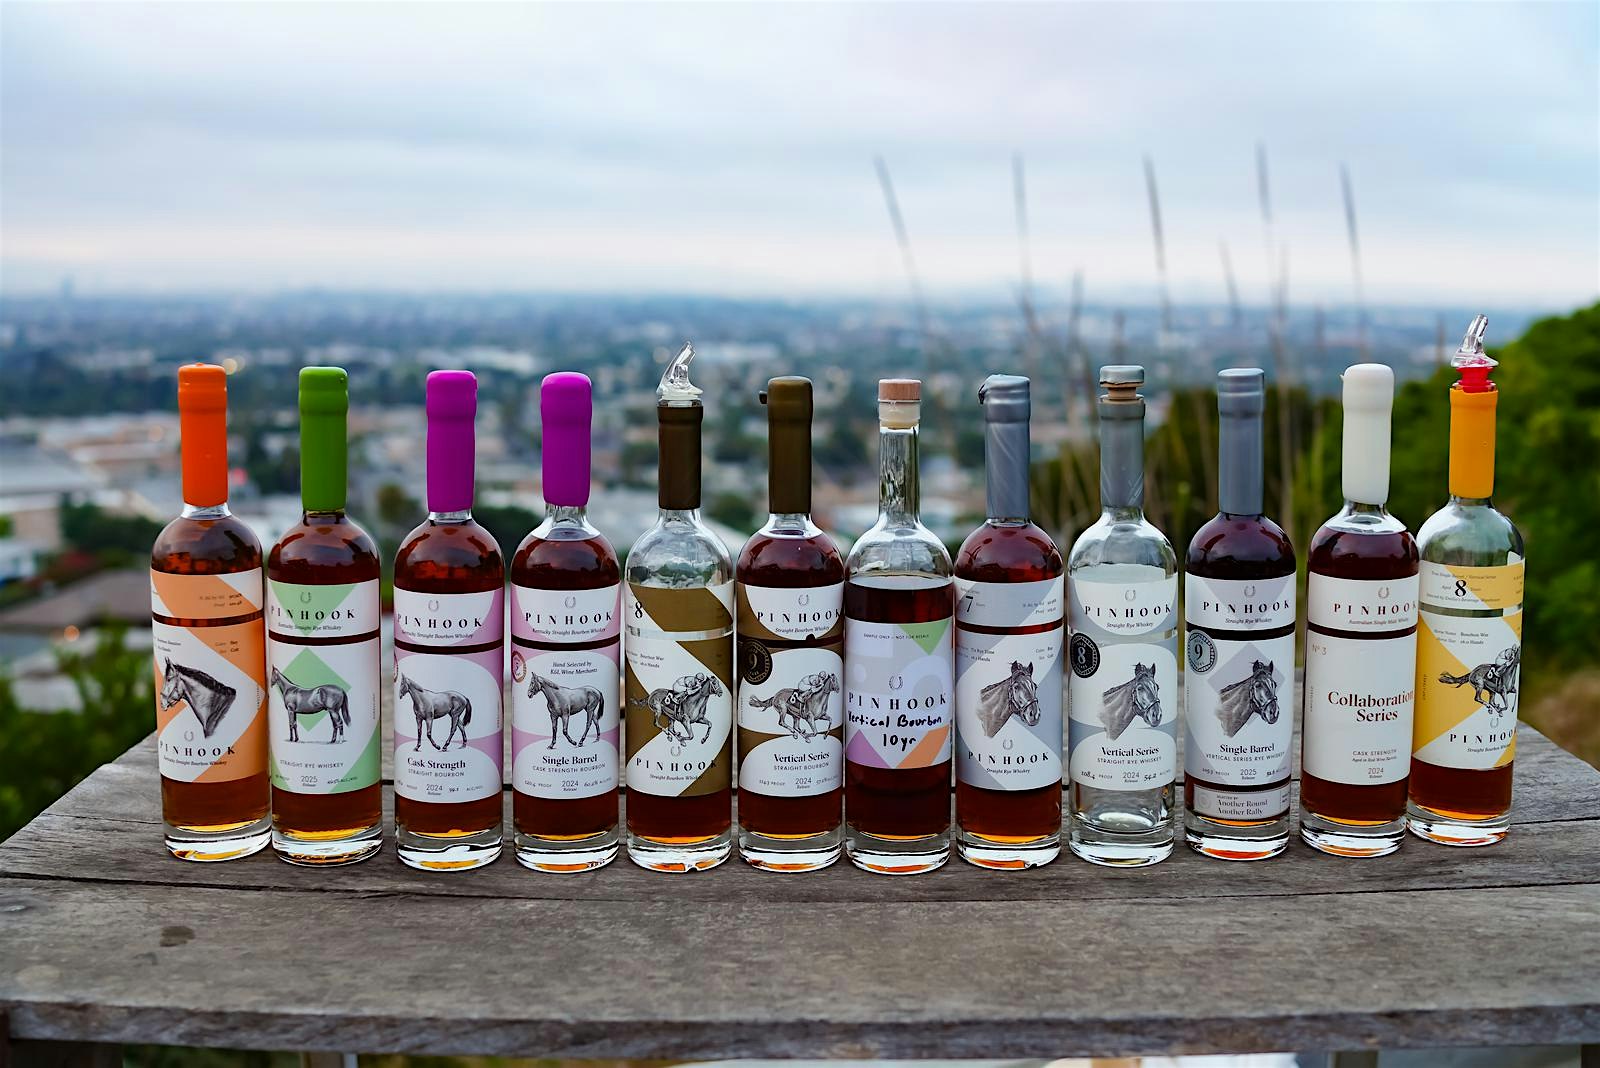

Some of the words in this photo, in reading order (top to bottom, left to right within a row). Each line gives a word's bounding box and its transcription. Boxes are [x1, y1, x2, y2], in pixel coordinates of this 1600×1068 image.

[1455, 580, 1466, 597] 8
[635, 601, 643, 618] 8
[965, 596, 973, 612] 7
[1085, 604, 1171, 618] PINHOOK
[1203, 600, 1289, 613] PINHOOK
[1334, 601, 1416, 615] PINHOOK
[271, 605, 355, 620] PINHOOK
[525, 612, 612, 625] PINHOOK
[757, 609, 840, 623] PINHOOK
[397, 614, 482, 629] PINHOOK
[1077, 646, 1086, 664] 8
[1194, 644, 1203, 660] 9
[1322, 647, 1327, 655] 3
[849, 692, 946, 710] PINHOOK
[1328, 690, 1414, 707] Collaboration
[897, 714, 942, 727] Bourbon
[1356, 708, 1398, 722] Series
[883, 733, 916, 751] 10yr
[1220, 743, 1248, 755] Single
[1250, 743, 1274, 754] Barrel
[774, 753, 805, 762] Vertical
[807, 752, 830, 761] Series
[968, 751, 1049, 765] PINHOOK
[1102, 746, 1133, 756] Vertical
[1135, 747, 1160, 755] Series
[407, 757, 425, 768] Cask
[427, 760, 466, 771] Strength
[542, 755, 570, 767] Single
[572, 754, 597, 764] Barrel
[580, 763, 605, 772] BOURBON
[636, 757, 717, 772] PINHOOK
[804, 762, 829, 770] BOURBON
[301, 775, 318, 783] 2025
[408, 768, 432, 777] STRAIGHT
[795, 777, 812, 785] 2024
[1219, 799, 1244, 807] Another
